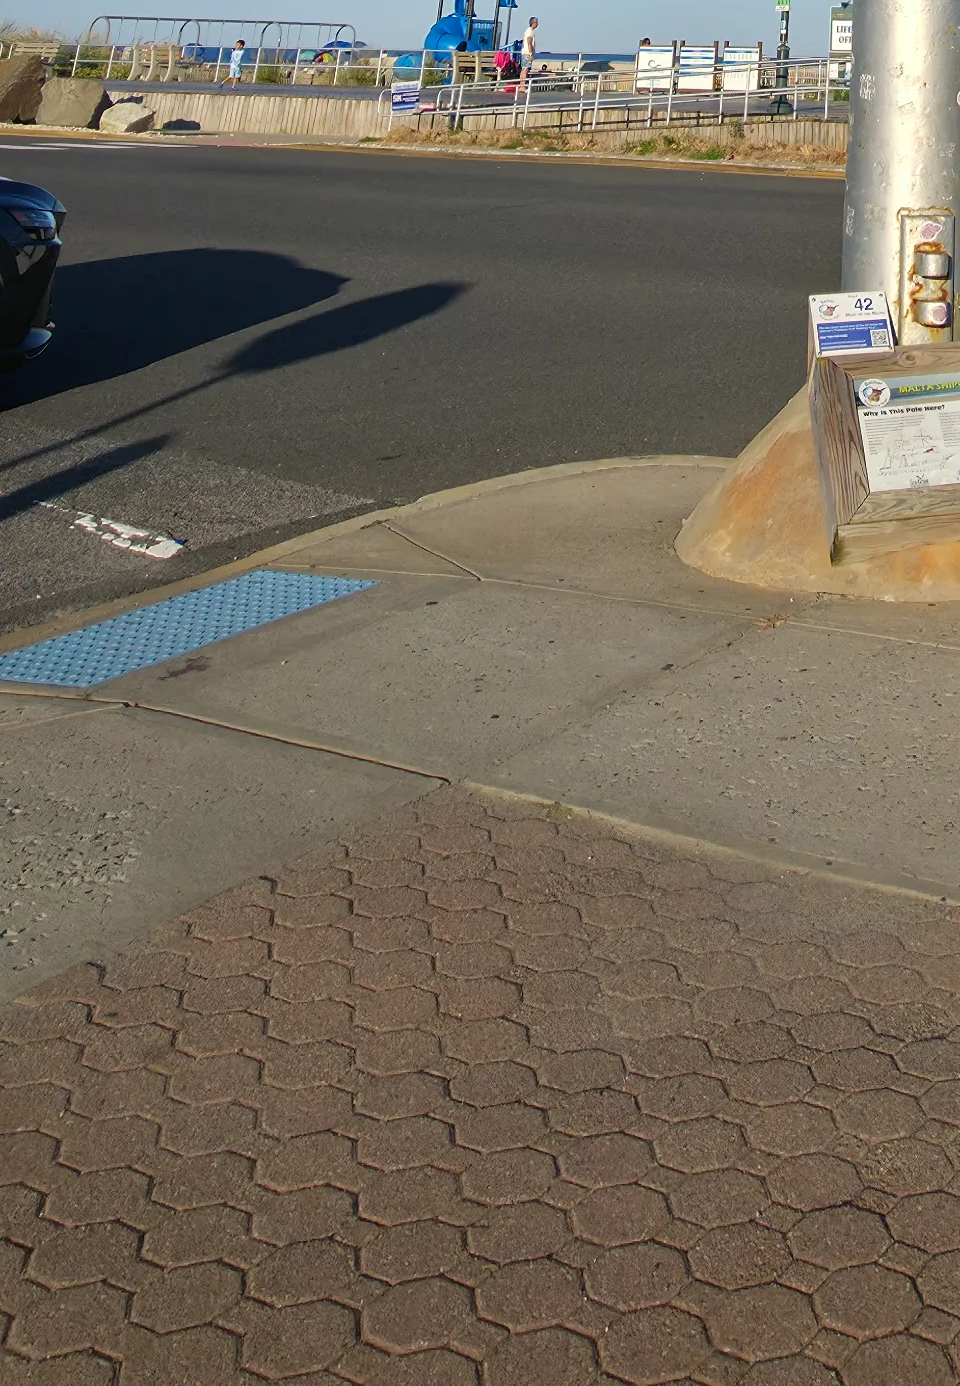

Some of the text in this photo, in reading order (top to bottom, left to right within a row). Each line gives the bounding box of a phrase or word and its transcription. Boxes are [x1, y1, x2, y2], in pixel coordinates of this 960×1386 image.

[854, 297, 873, 311] 42
[899, 384, 934, 393] MALTA
[906, 406, 923, 414] Pole
[924, 404, 945, 412] Here?
